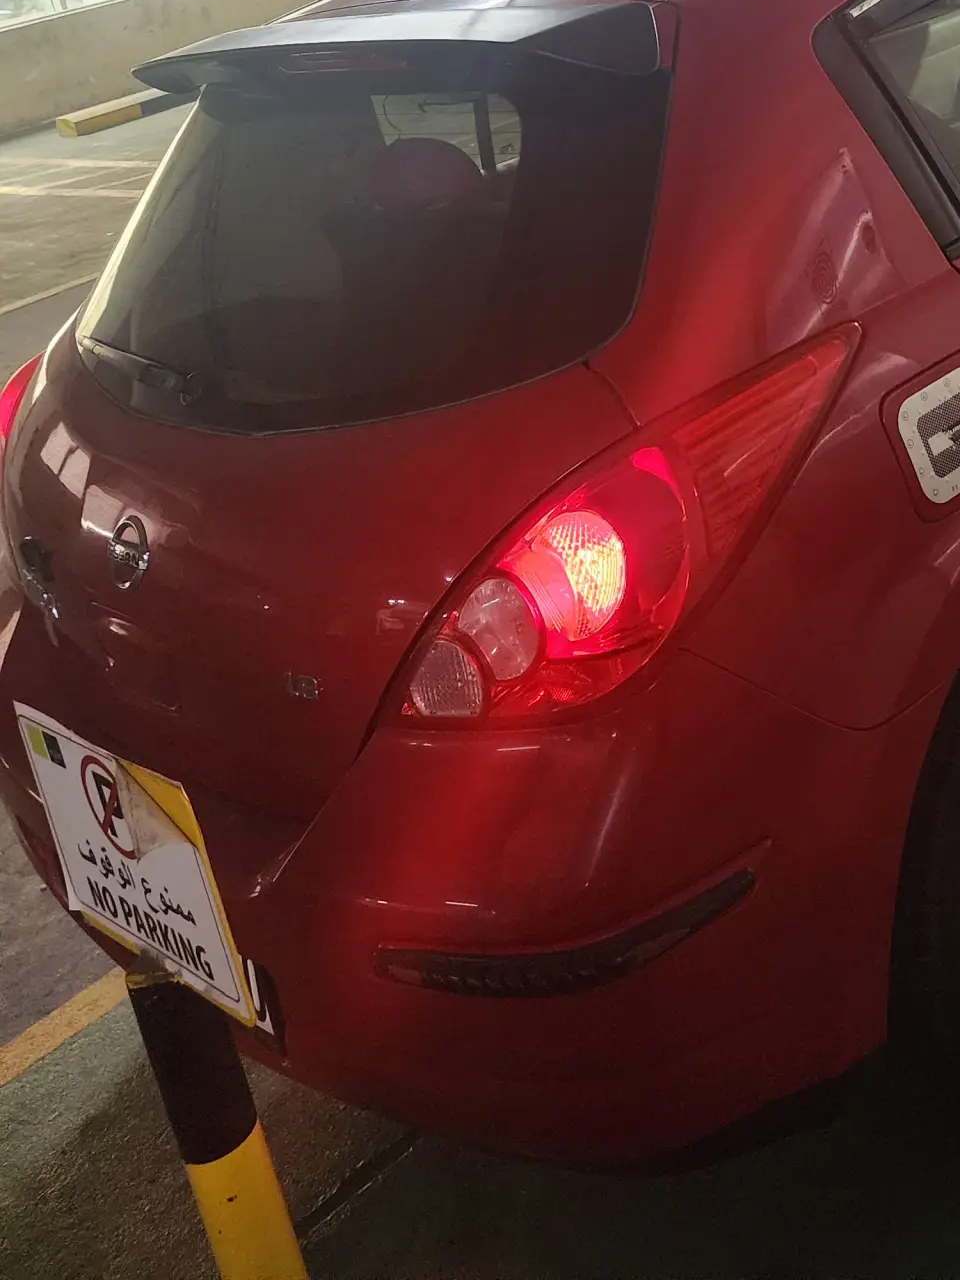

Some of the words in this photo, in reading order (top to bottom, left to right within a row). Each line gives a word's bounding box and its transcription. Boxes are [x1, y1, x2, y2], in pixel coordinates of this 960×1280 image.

[78, 838, 136, 890] الوقوف
[140, 877, 197, 926] ممنوع
[86, 876, 118, 919] NO
[118, 895, 215, 981] PARKING
